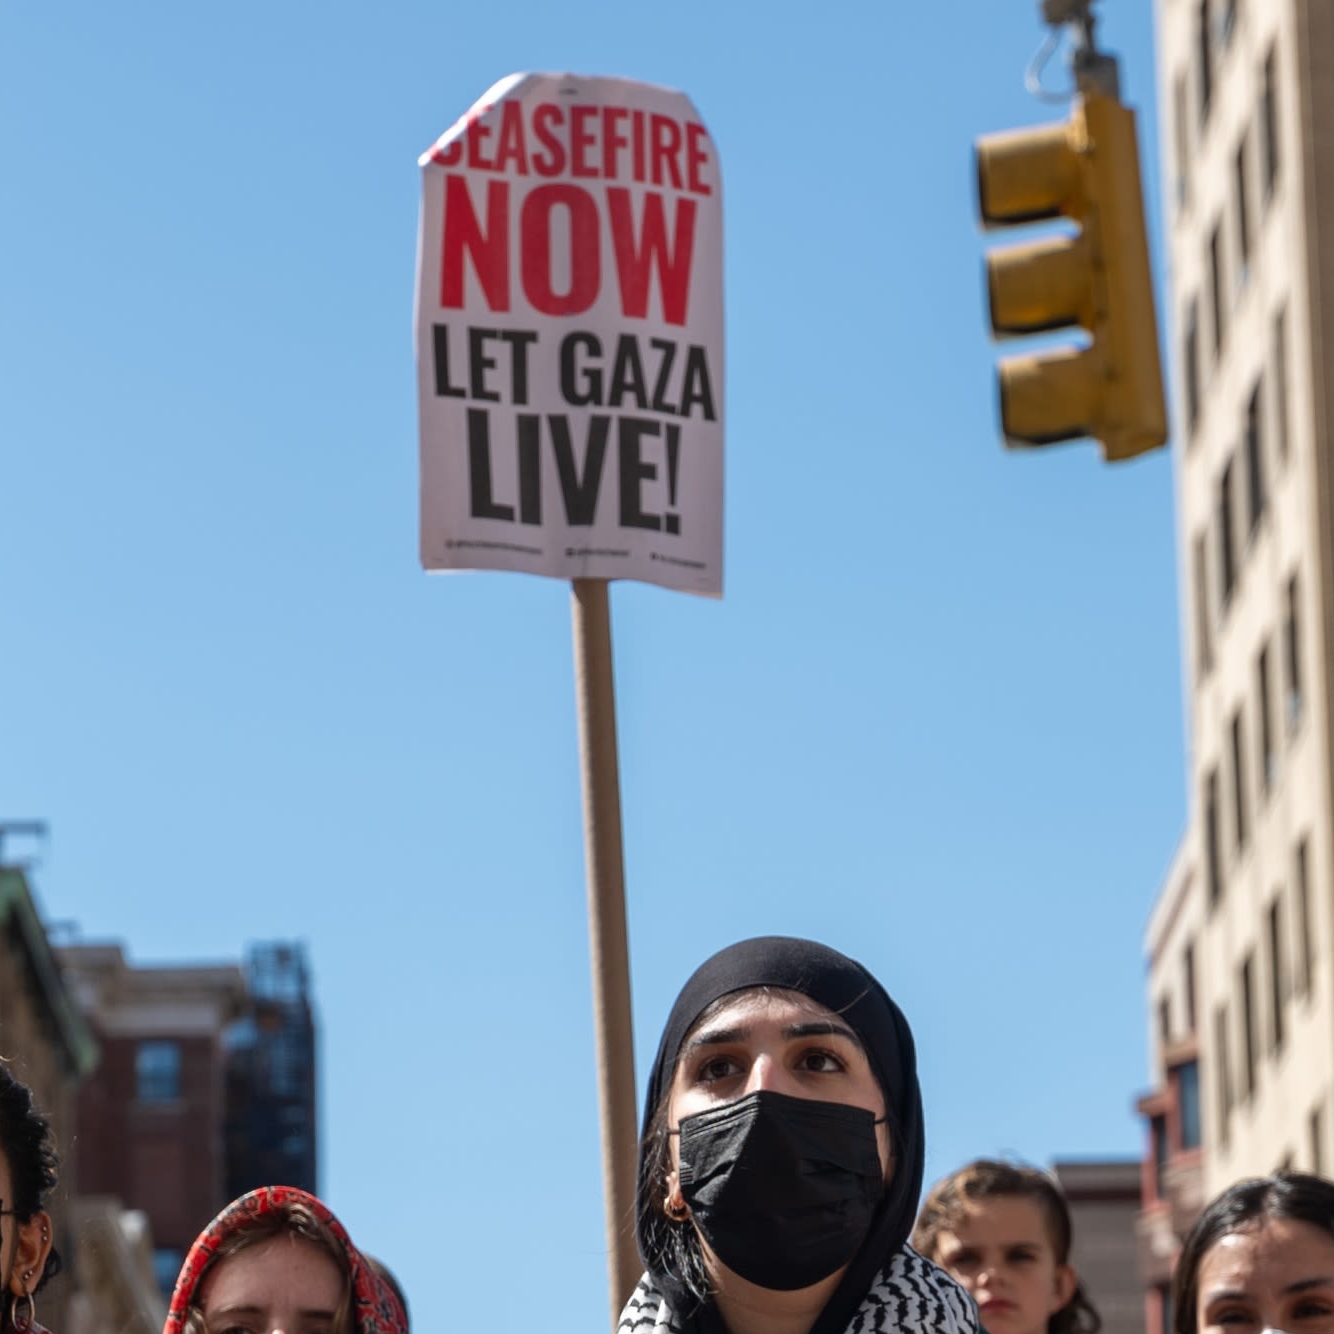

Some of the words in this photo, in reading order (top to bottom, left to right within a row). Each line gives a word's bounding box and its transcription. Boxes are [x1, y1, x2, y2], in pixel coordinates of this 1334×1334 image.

[440, 174, 697, 327] NOW
[431, 322, 538, 405] LET
[559, 330, 717, 423] GAZA
[466, 406, 682, 537] LIVE!
